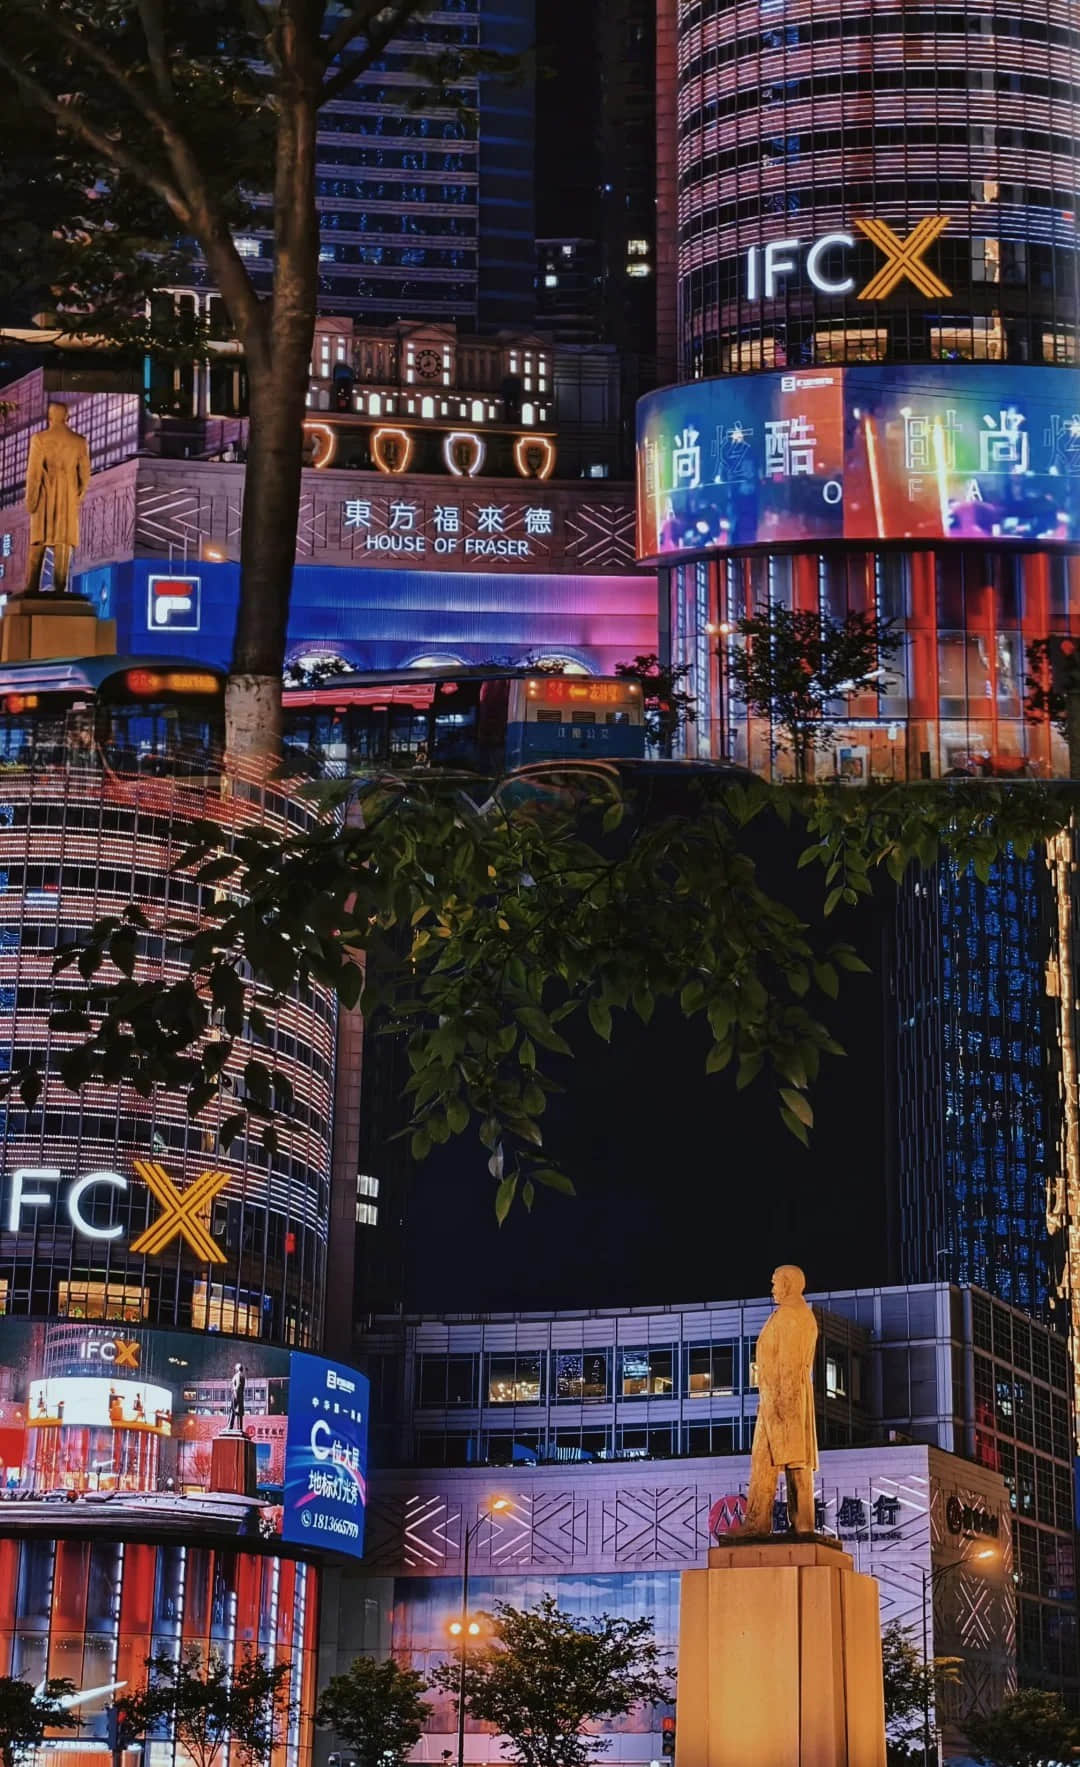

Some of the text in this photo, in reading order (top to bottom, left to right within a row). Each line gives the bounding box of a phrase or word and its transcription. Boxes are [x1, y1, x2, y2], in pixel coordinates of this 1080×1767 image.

[344, 498, 552, 534] 東方福來德
[367, 535, 529, 556] HOUSE OF FRASER
[308, 1469, 358, 1507] 地标灯光秀
